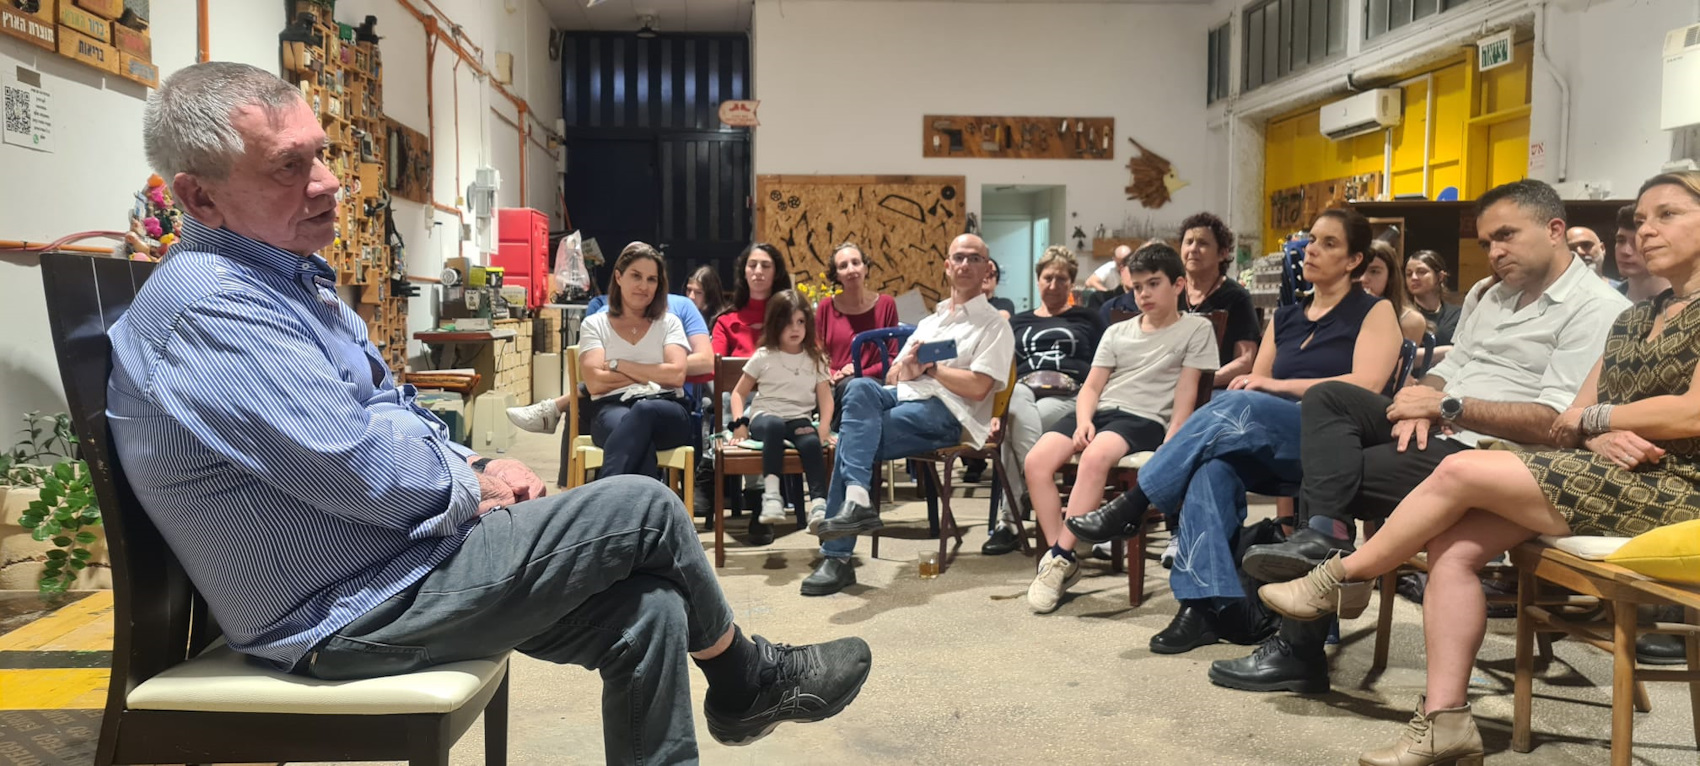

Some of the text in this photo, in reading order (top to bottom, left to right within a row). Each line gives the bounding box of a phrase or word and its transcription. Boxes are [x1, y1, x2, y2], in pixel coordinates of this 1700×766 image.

[2, 11, 27, 33] הארץ
[79, 40, 104, 62] בריאות
[1481, 38, 1508, 68] יציאה
[1531, 142, 1544, 156] אש
